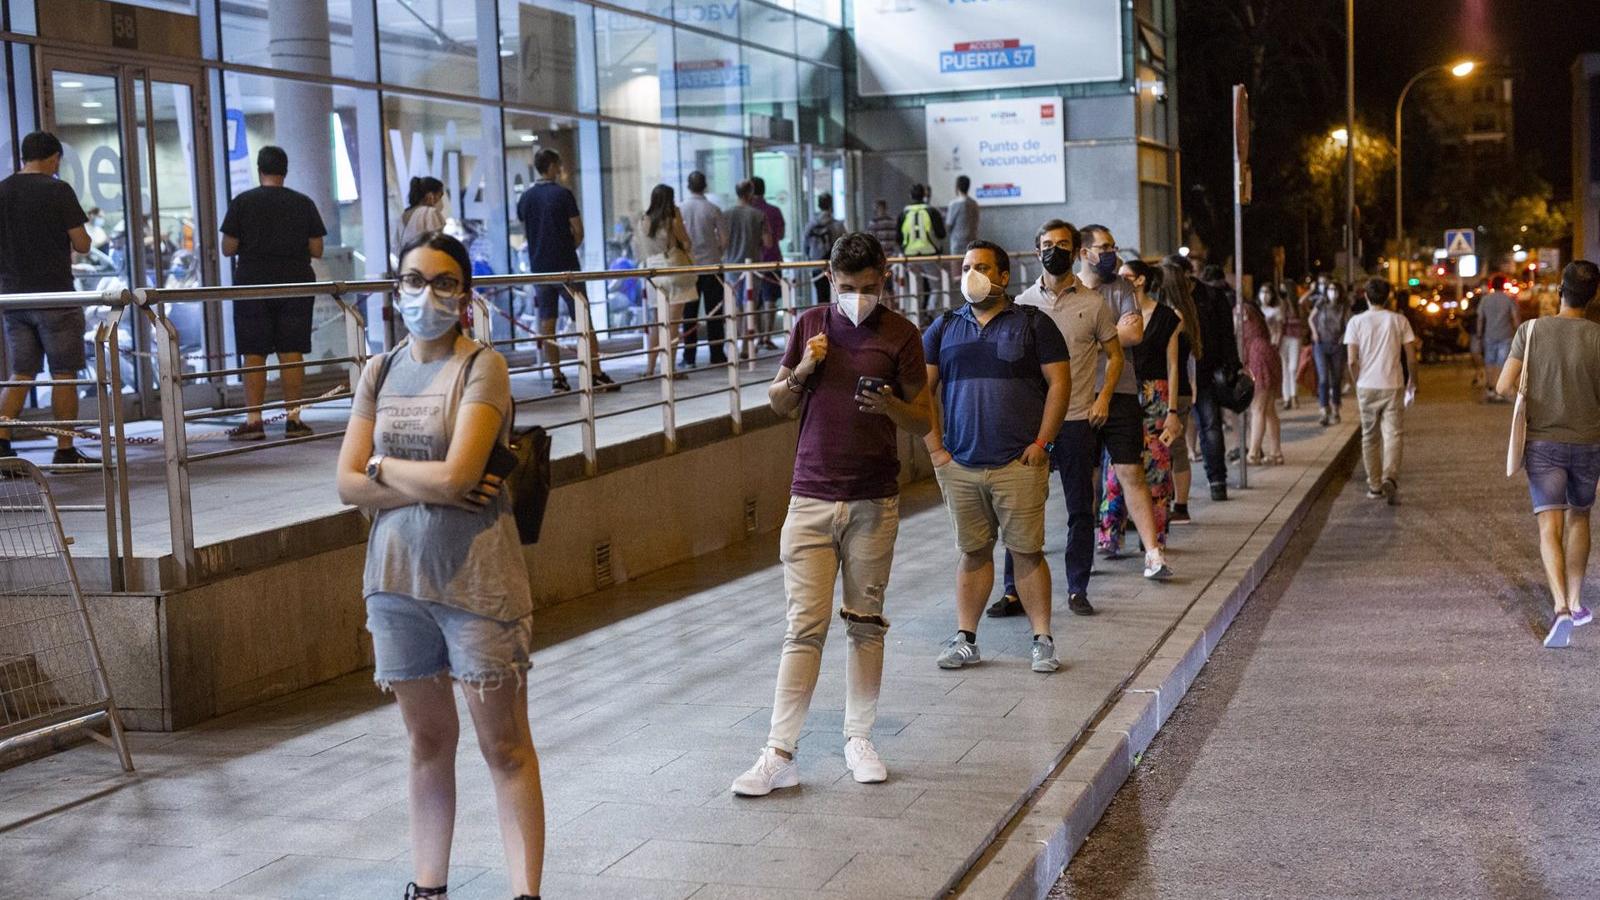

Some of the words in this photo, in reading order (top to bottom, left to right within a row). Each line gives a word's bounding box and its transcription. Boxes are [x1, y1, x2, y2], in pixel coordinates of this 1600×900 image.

[114, 15, 135, 38] 58
[969, 41, 1004, 51] ACCESO
[942, 51, 1010, 70] PUERTA
[1013, 48, 1033, 66] 57
[980, 140, 1019, 153] Punto
[1023, 139, 1040, 151] de
[980, 153, 1056, 167] vacunación
